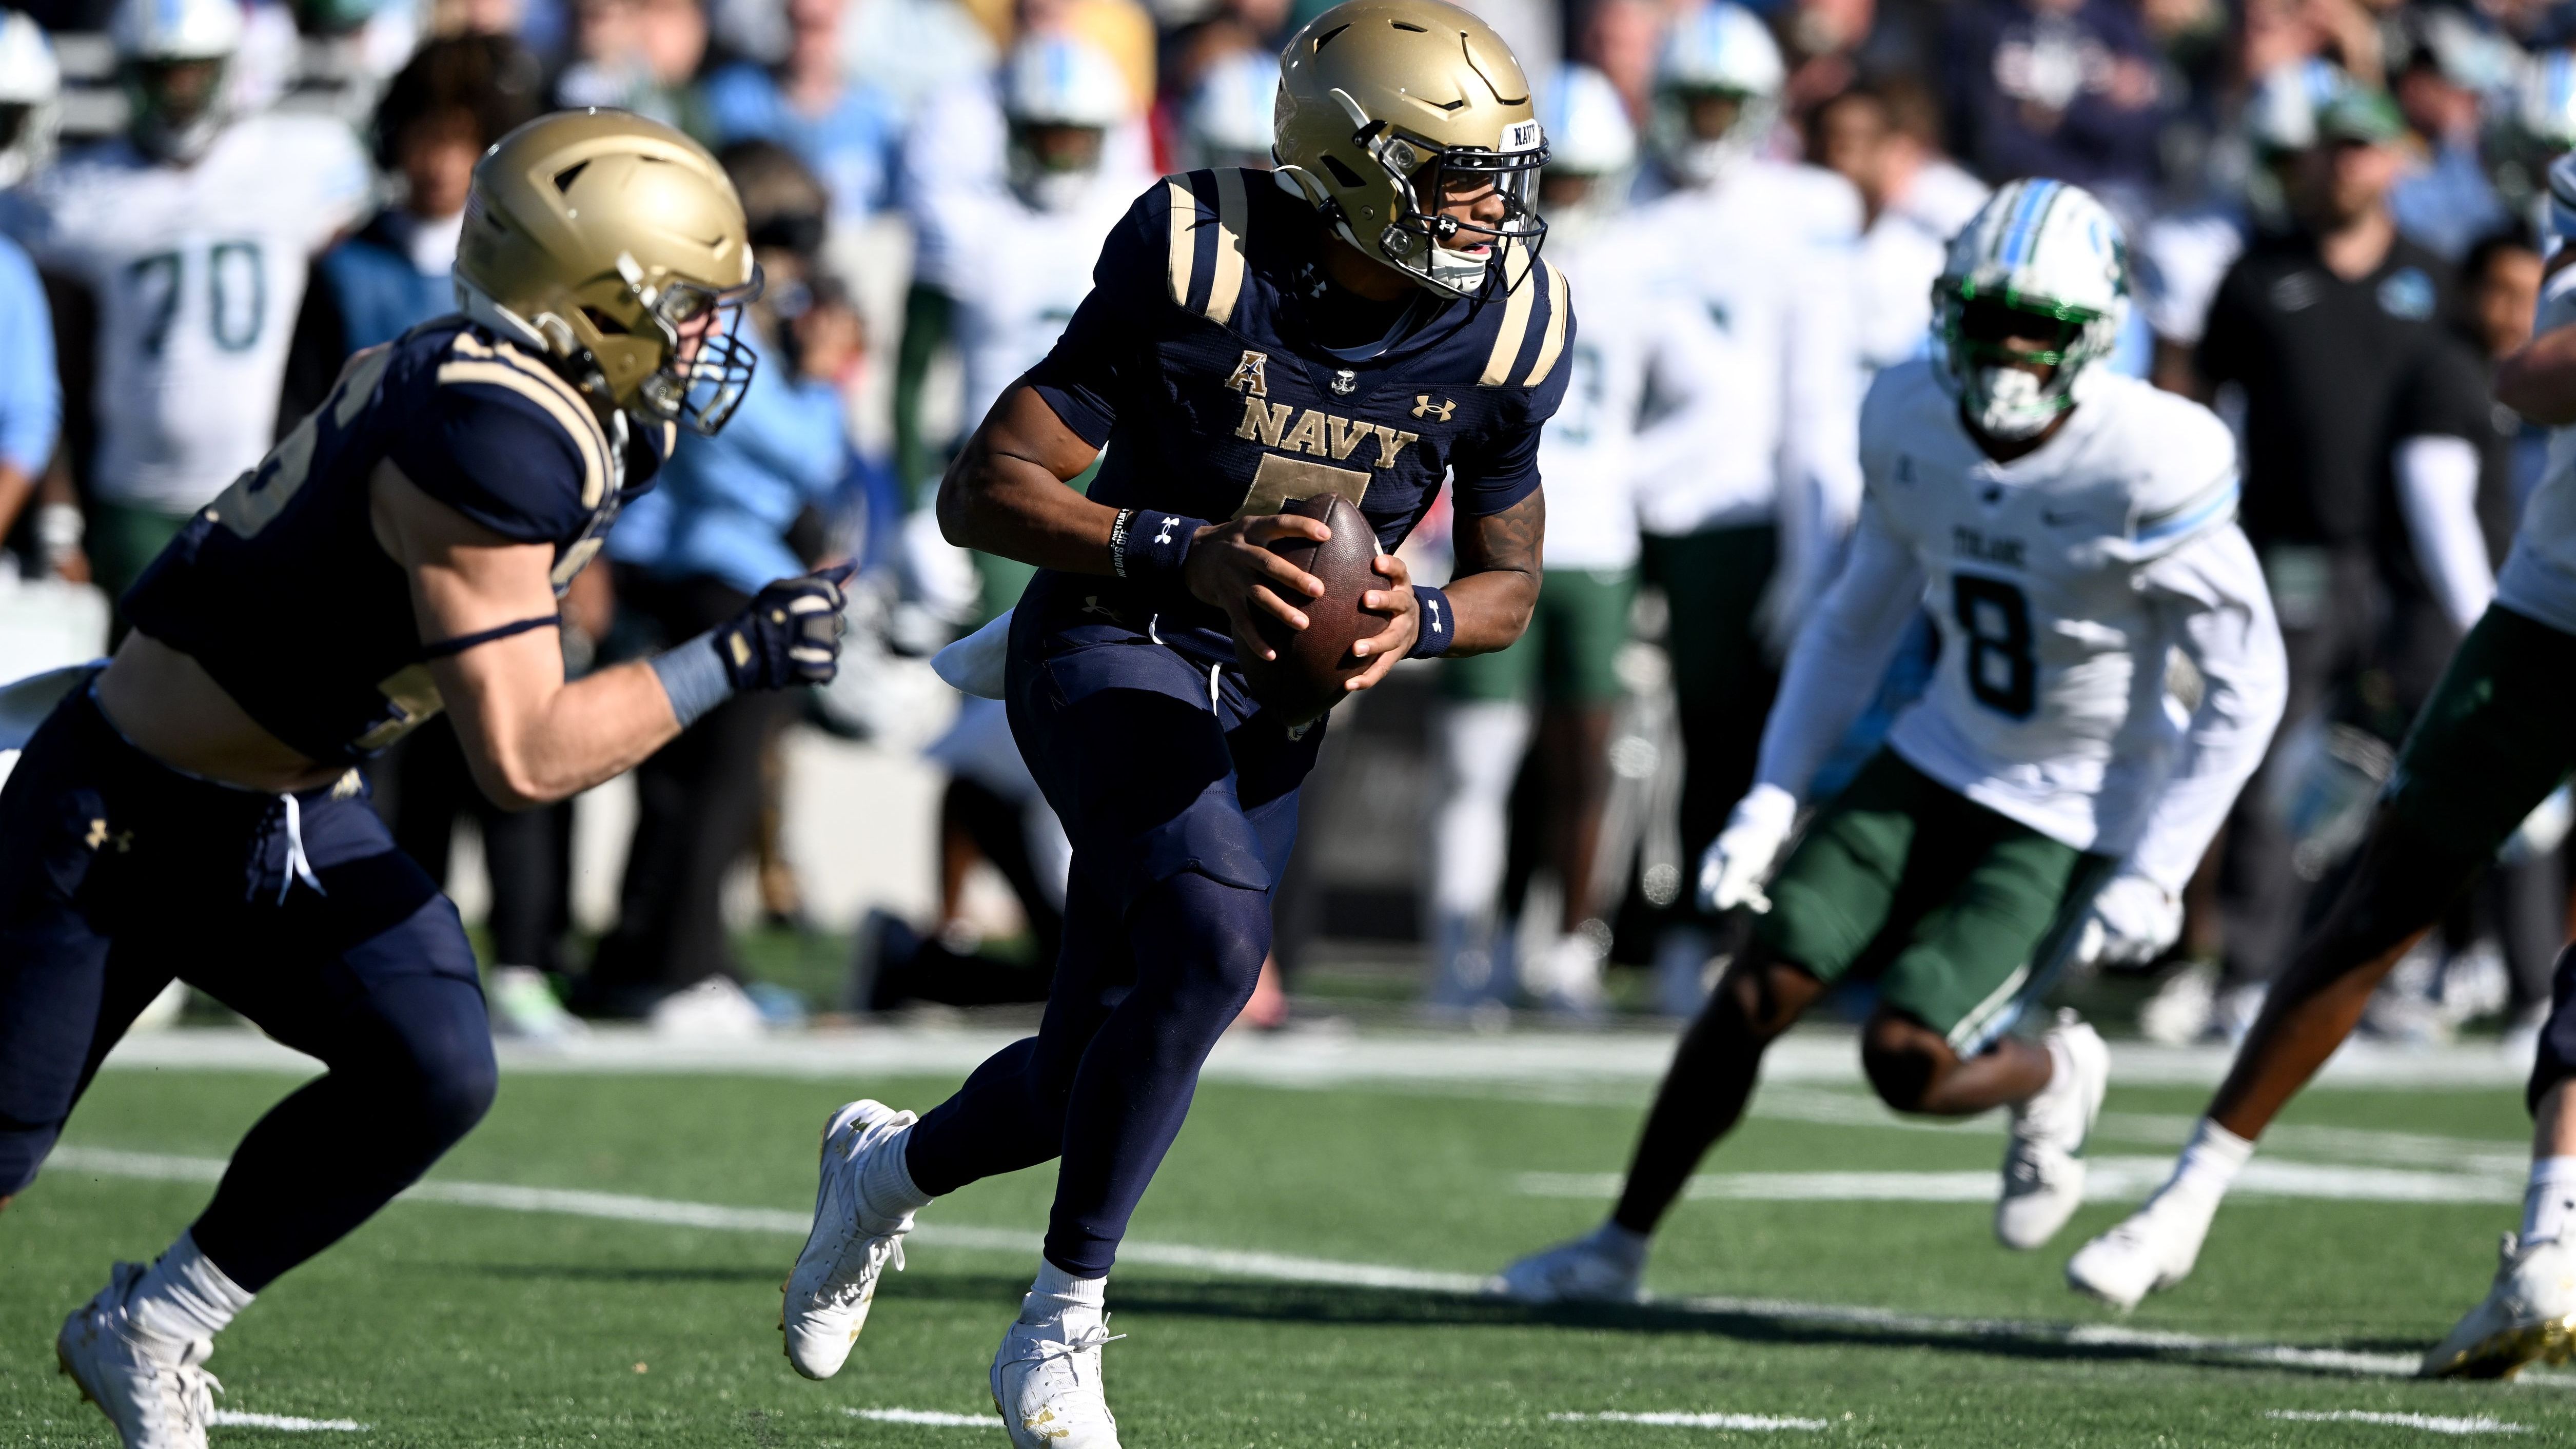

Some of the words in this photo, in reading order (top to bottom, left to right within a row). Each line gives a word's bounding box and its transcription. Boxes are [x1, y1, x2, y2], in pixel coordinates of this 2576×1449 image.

[1514, 124, 1535, 146] NAVY
[127, 242, 266, 356] 70
[1235, 396, 1419, 468] NAVY
[1116, 513, 1126, 525] PLAN
[1116, 528, 1129, 545] OFF
[1114, 546, 1124, 567] DAYS
[1116, 568, 1127, 578] NO
[1953, 573, 2037, 720] 8
